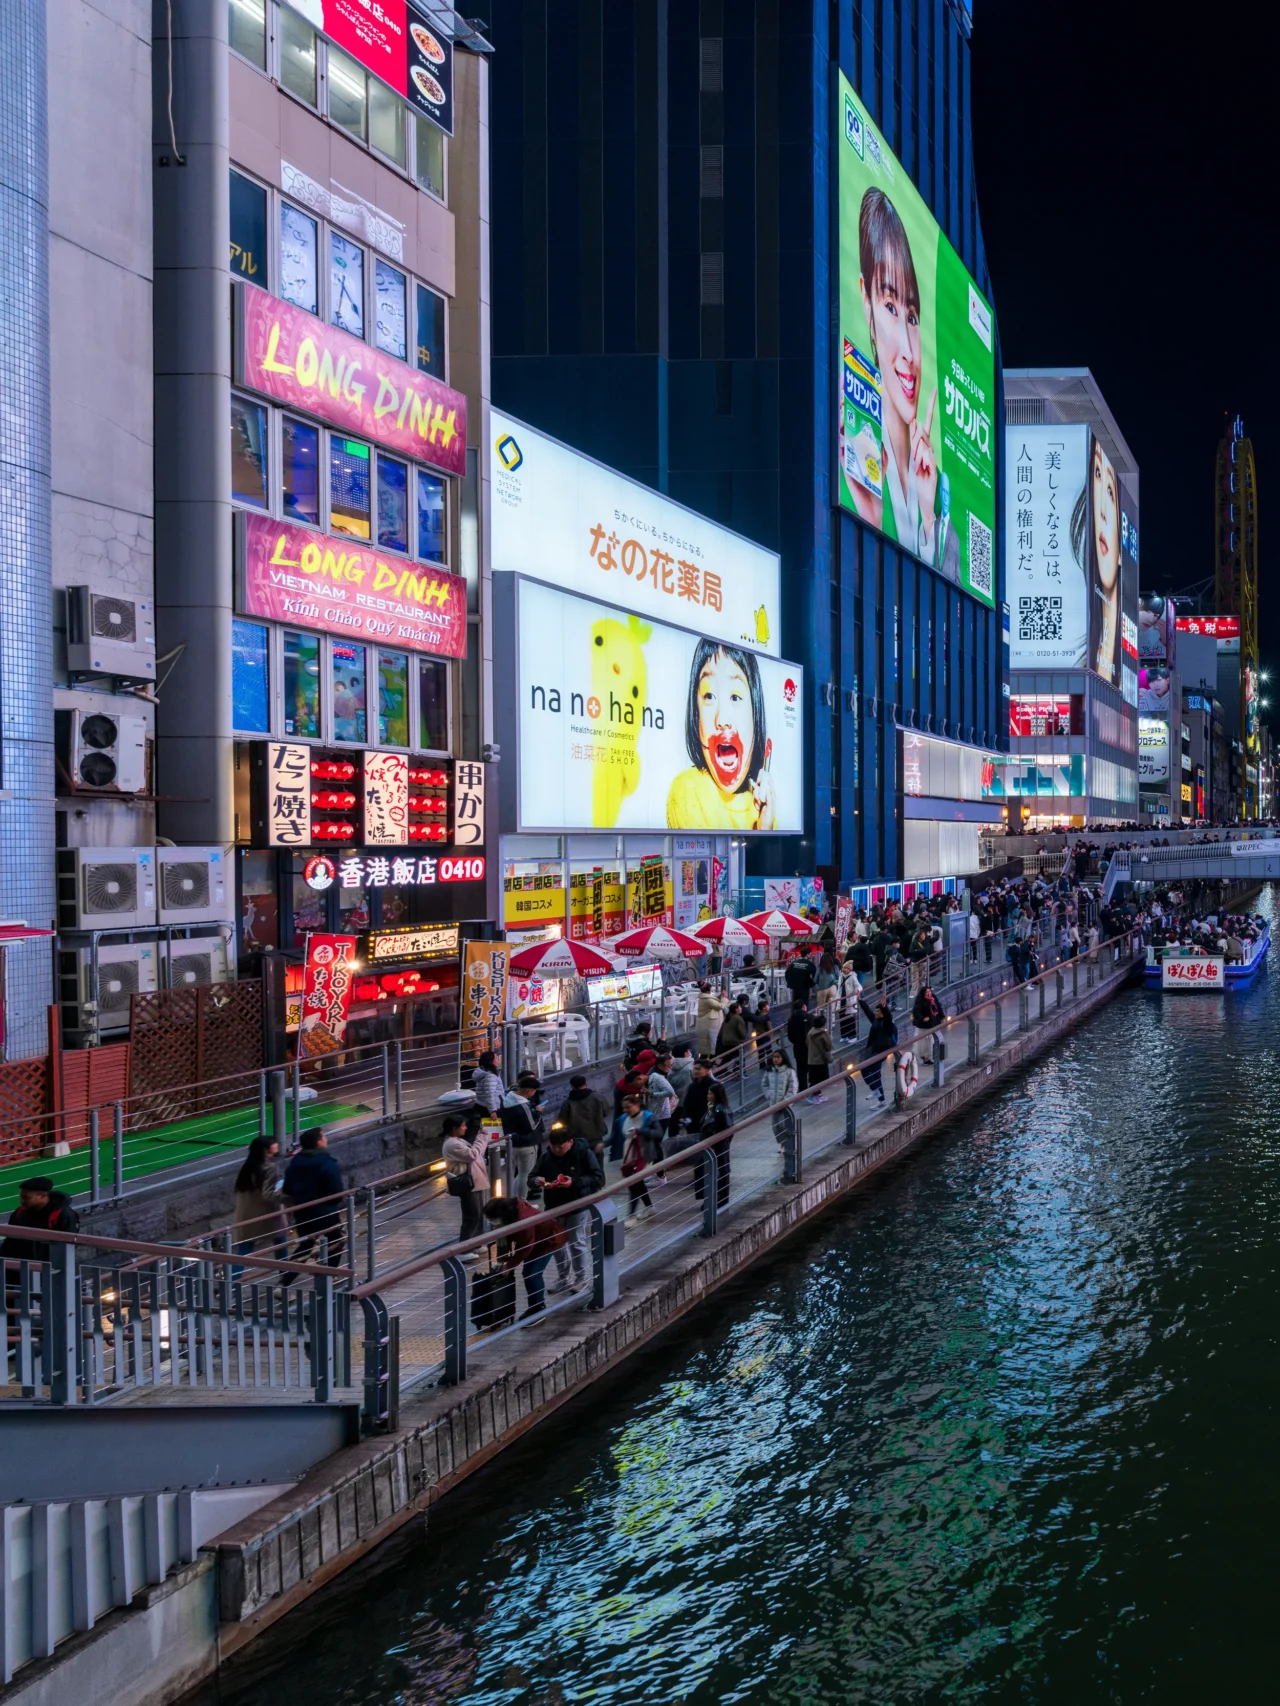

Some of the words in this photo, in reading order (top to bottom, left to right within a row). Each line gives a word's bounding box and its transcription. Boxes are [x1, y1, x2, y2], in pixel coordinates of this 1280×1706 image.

[260, 321, 368, 412] LONG
[374, 372, 458, 449] DINH
[944, 374, 992, 461] サロンパス
[496, 469, 522, 485] MEDICAL
[498, 479, 521, 493] SYSTEM
[269, 534, 366, 586] LONG
[372, 562, 451, 608] DINH
[589, 522, 723, 613] なの花薬局
[270, 570, 346, 600] VIETNAM
[356, 593, 451, 626] RESTAURANT
[283, 597, 320, 618] Kính
[324, 607, 362, 628] Chào
[366, 618, 395, 637] Quý
[397, 625, 441, 646] Khách!
[571, 724, 602, 739] Healthcare
[607, 729, 635, 742] Cosmetics
[611, 756, 636, 765] SHOP
[272, 745, 308, 844] たこ焼き
[457, 763, 483, 844] 串かつ
[338, 856, 438, 889] 香港飯店
[441, 860, 483, 880] 0410
[516, 899, 553, 912] 韓国コスメ
[644, 866, 665, 915] 閉店
[620, 947, 641, 955] KIRIN
[685, 949, 703, 957] KIRIN
[509, 967, 528, 976] KIRIN
[583, 967, 606, 976] KIRIN
[1167, 963, 1218, 979] ぽんぽん船
[327, 943, 352, 1034] TAKOYAKI
